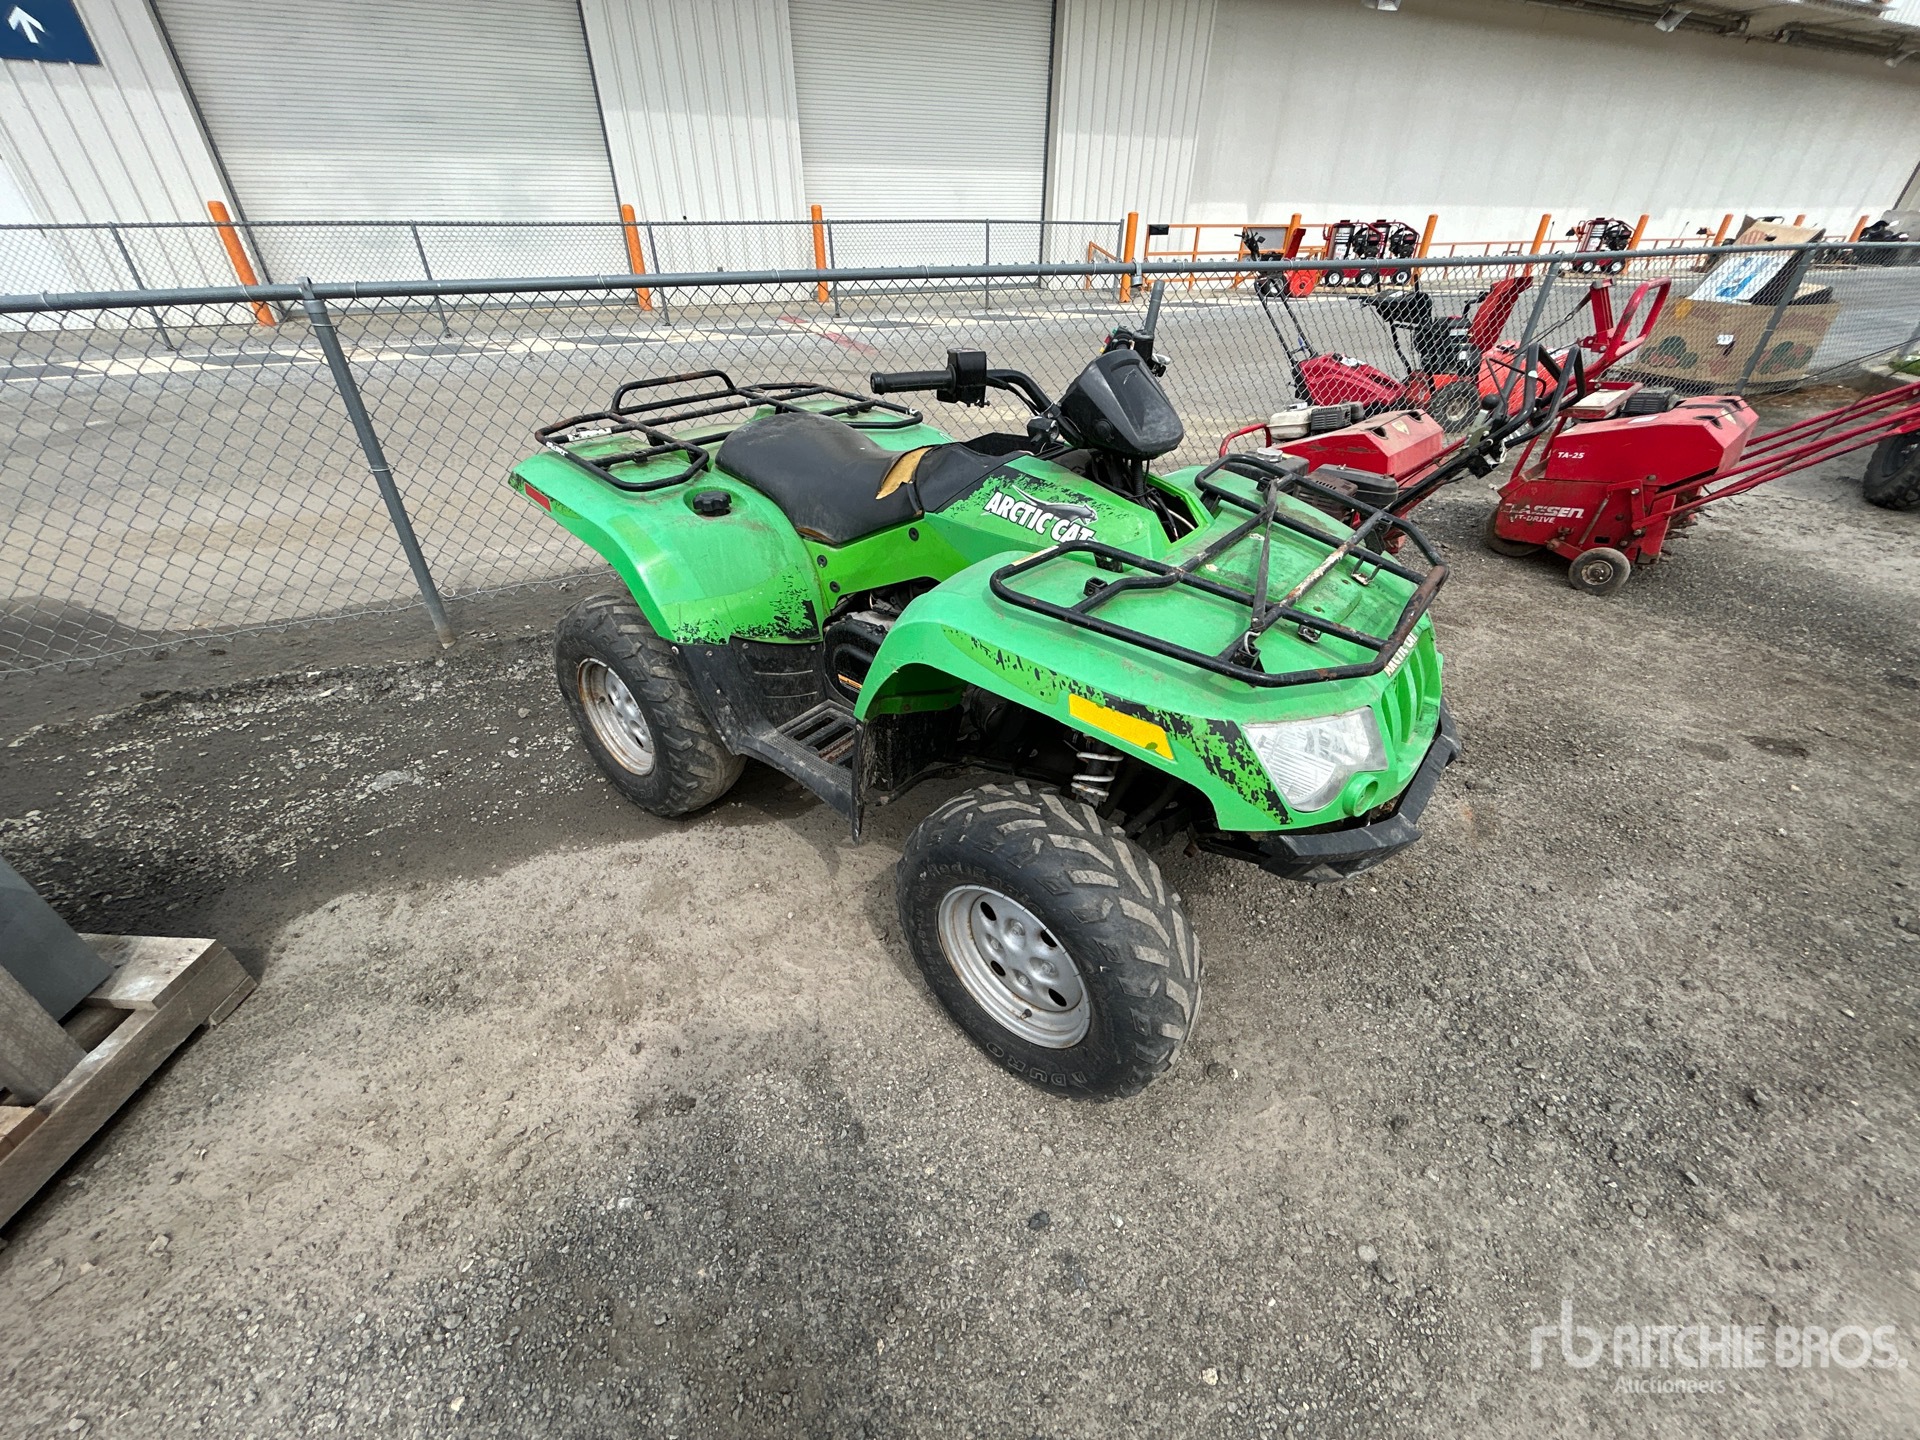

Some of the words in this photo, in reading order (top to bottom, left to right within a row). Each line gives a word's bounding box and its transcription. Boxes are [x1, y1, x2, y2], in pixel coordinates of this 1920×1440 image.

[1557, 451, 1585, 459] TA-25
[984, 491, 1052, 535] ARCTIC
[1050, 518, 1097, 543] CAT
[986, 1042, 1067, 1087] DURO
